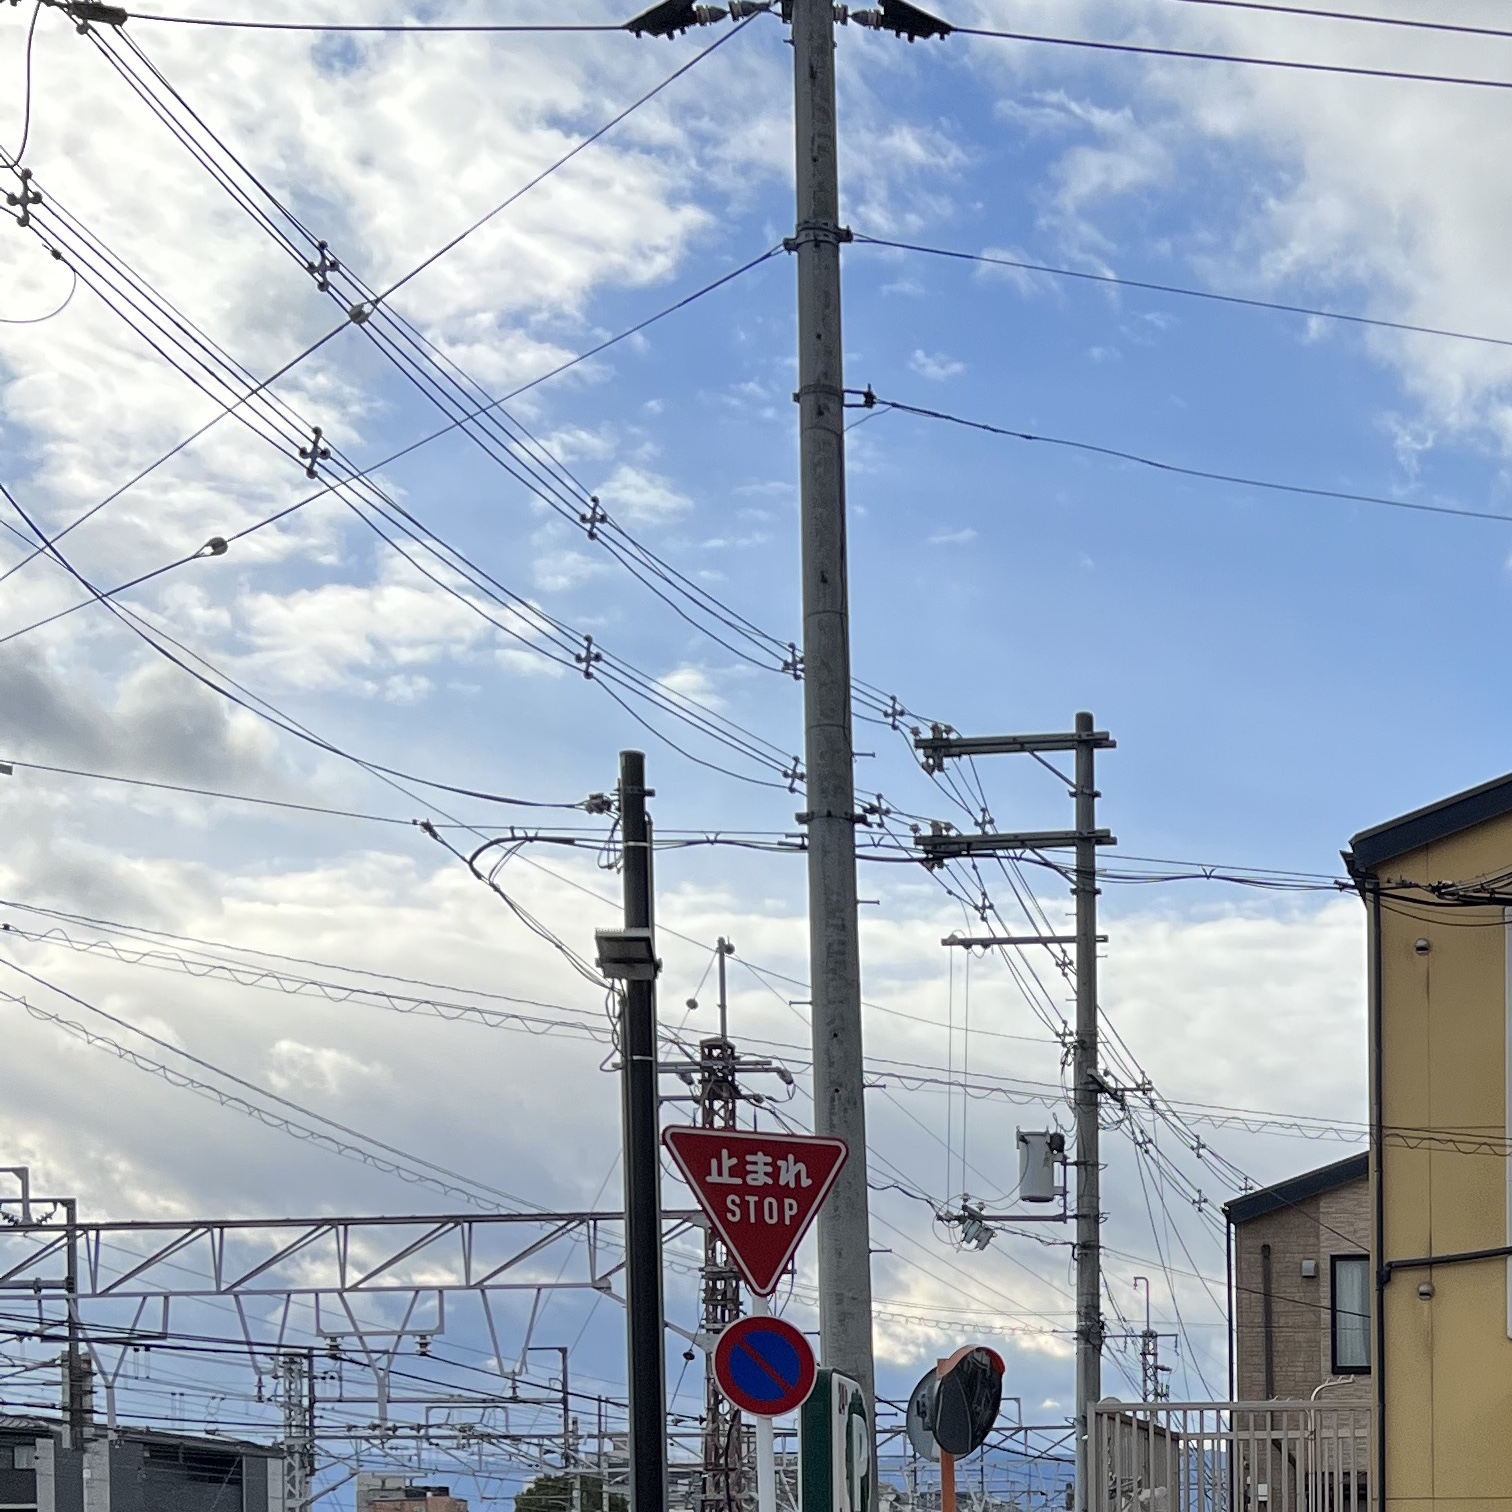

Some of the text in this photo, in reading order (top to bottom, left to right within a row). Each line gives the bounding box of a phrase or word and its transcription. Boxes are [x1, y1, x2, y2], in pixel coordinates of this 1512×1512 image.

[705, 1148, 813, 1188] 止まれ
[726, 1194, 798, 1225] STOP
[852, 1413, 868, 1512] P
